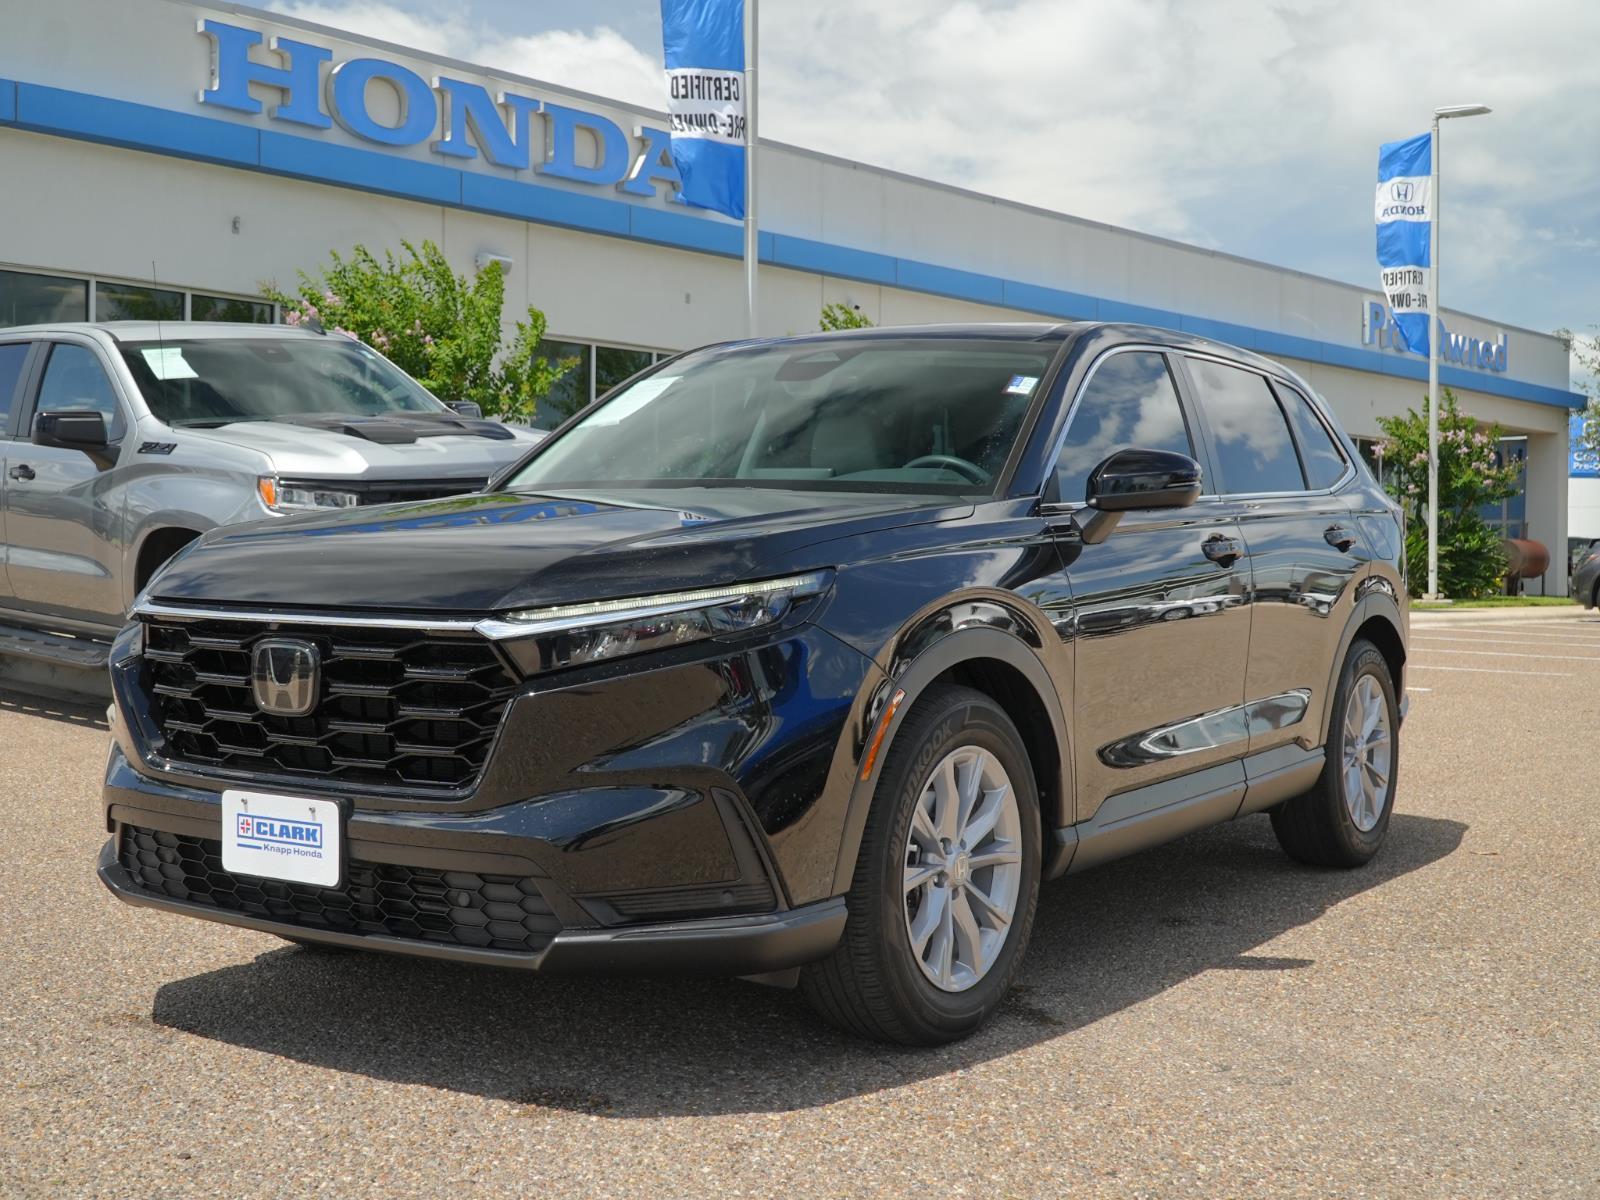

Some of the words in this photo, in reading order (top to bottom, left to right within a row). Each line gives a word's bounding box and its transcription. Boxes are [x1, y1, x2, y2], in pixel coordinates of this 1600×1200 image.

[197, 18, 684, 205] HONDA
[256, 821, 318, 843] CLARK
[263, 843, 292, 855] Knapp
[293, 846, 323, 859] Honda
